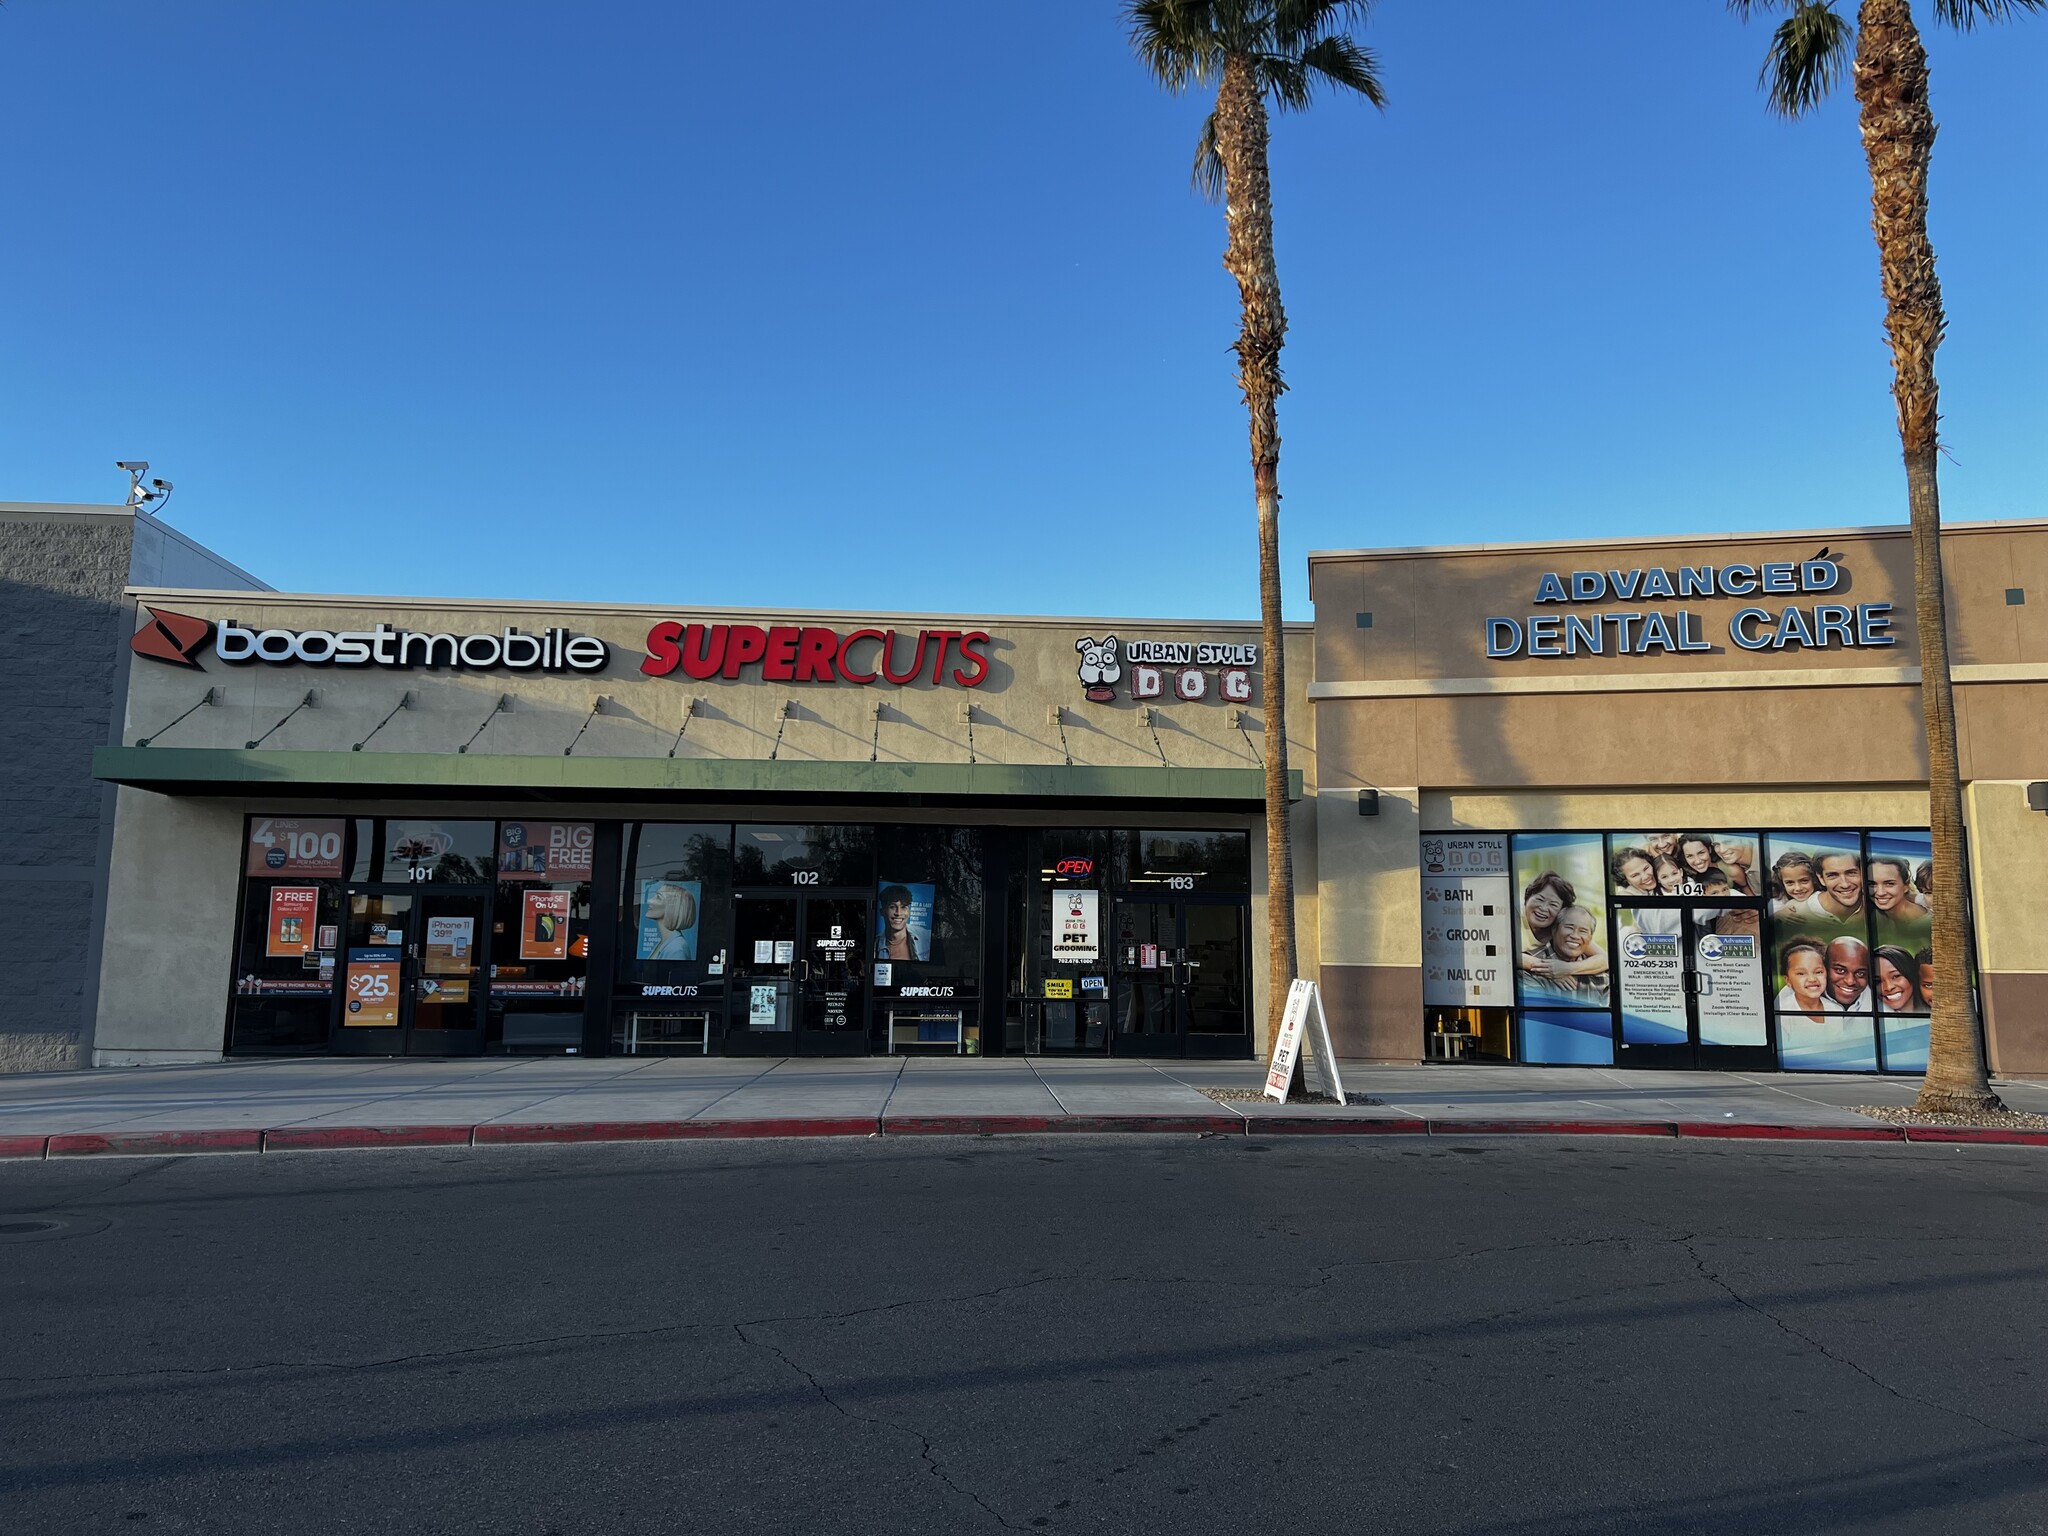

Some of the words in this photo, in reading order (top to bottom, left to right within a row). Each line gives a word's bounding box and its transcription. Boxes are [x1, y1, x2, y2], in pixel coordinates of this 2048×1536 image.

[1534, 560, 1839, 605] ADVANCED
[1485, 610, 1712, 659] DENTAL
[1729, 603, 1897, 652] CARE
[640, 621, 990, 687] SUPERCUTS
[1126, 640, 1191, 663] URBAN
[1195, 641, 1256, 665] STYLE
[252, 820, 276, 848] 4
[275, 821, 299, 829] LINES
[506, 827, 521, 837] BIG
[550, 826, 593, 848] BIG
[279, 831, 341, 860] $100
[509, 835, 521, 844] AF
[1447, 841, 1474, 849] URBAN
[1478, 841, 1502, 849] STYLE
[549, 848, 592, 864] FREE
[1057, 860, 1093, 873] OPEN
[407, 867, 433, 880] 101
[791, 871, 819, 885] 102
[1168, 876, 1194, 890] 103
[1673, 883, 1703, 896] 104
[276, 892, 283, 902] 2
[284, 892, 314, 902] FREE
[1444, 889, 1473, 901] BATH
[1062, 934, 1088, 942] PET
[1446, 929, 1490, 941] GROOM
[816, 939, 855, 947] SUPERCUTS
[1624, 960, 1678, 968] 702-405-2381
[1447, 969, 1473, 981] NAIL
[1475, 970, 1497, 981] CUT
[350, 974, 390, 997] $25
[1083, 979, 1102, 988] OPEN
[641, 985, 698, 996] SUPERCUTS
[900, 986, 954, 997] SUPERCUTS
[1278, 1049, 1290, 1063] PET
